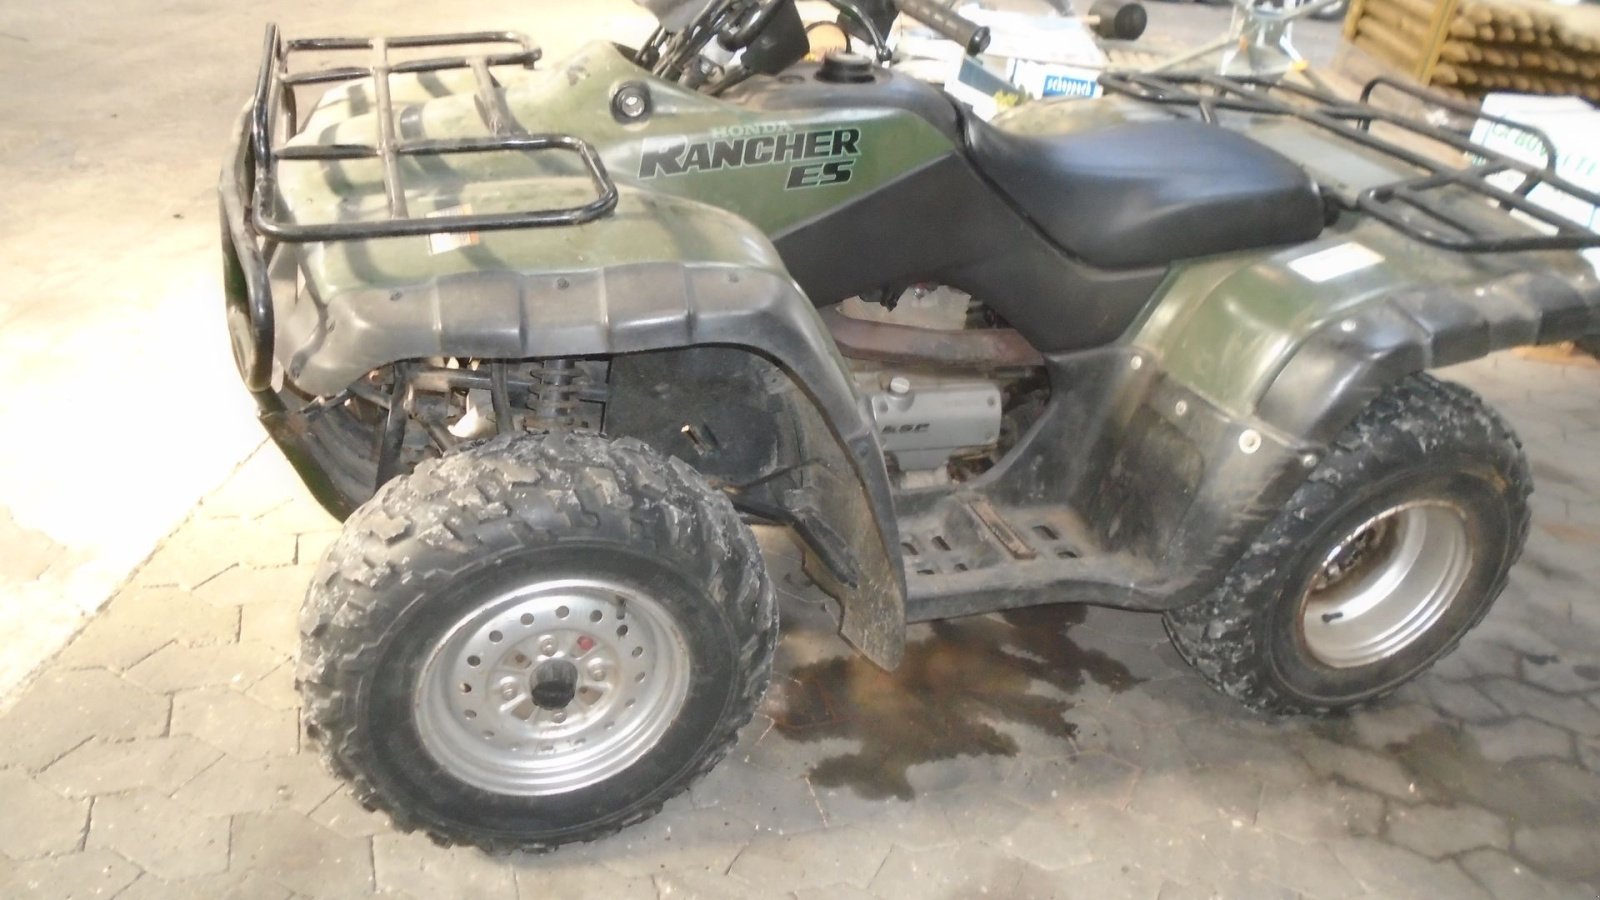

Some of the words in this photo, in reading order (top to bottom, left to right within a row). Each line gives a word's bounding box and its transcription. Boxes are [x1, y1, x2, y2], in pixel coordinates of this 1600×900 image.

[710, 121, 793, 139] HONDA
[638, 128, 862, 180] RANCHER
[785, 160, 857, 190] ES
